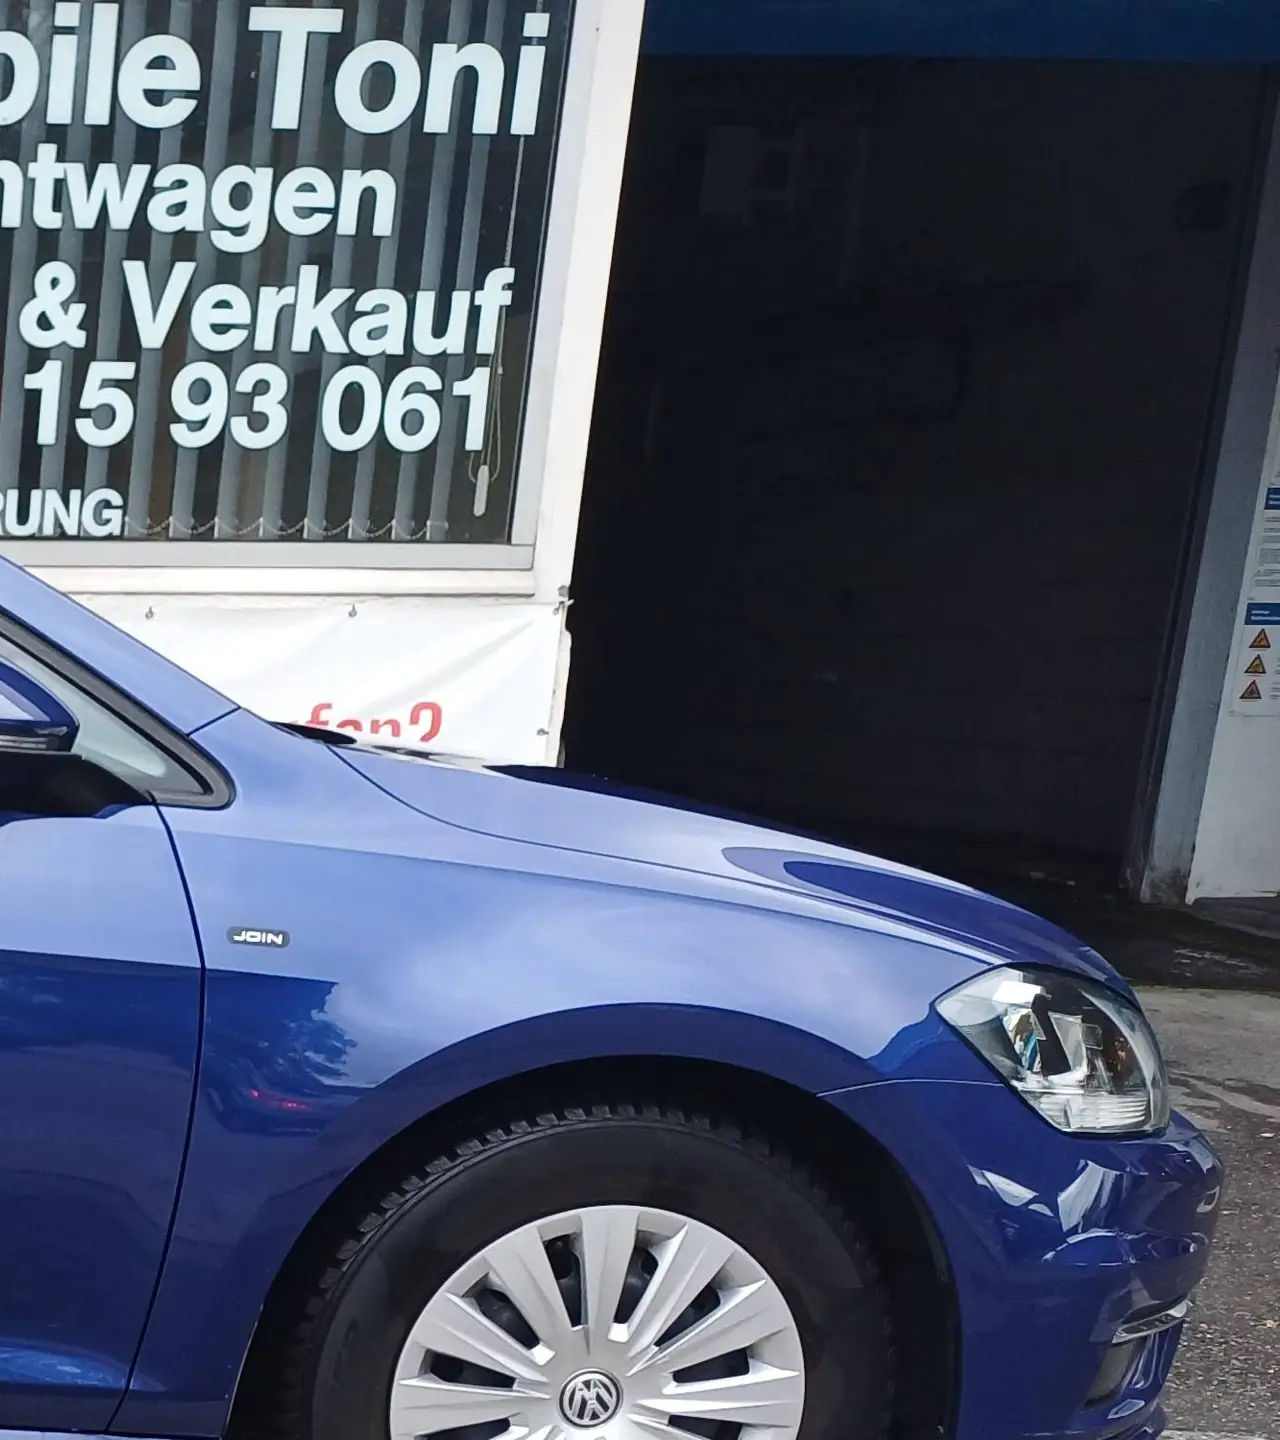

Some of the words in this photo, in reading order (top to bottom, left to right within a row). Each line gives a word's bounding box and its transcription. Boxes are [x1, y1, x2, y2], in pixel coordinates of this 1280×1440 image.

[248, 6, 551, 136] Toni
[18, 260, 88, 349] &
[121, 260, 516, 356] Verkauf
[23, 359, 137, 448] 15
[169, 360, 289, 450] 93
[320, 364, 493, 453] 061
[232, 930, 284, 945] JOIN
